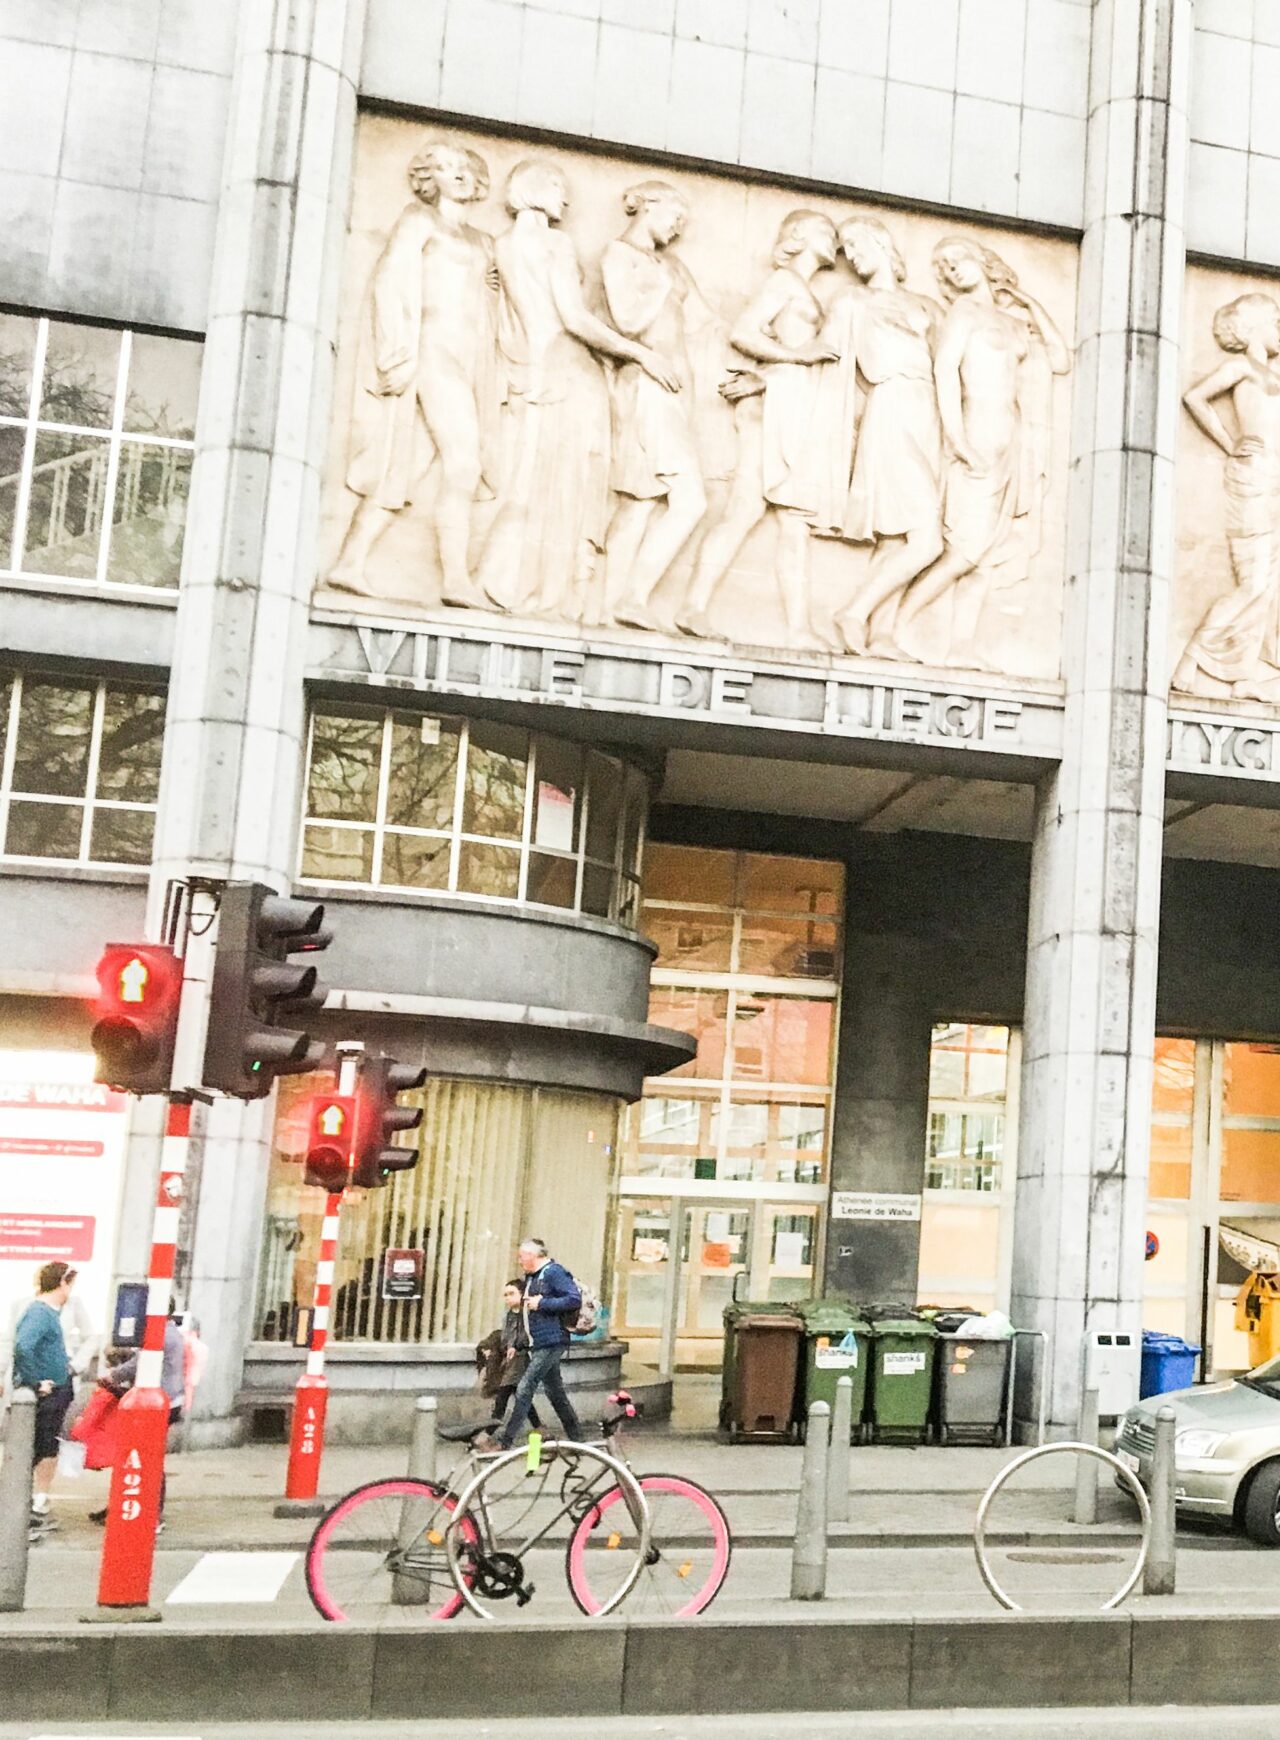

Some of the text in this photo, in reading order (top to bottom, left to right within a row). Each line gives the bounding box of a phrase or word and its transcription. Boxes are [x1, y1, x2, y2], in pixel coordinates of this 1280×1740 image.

[356, 627, 1022, 741] VILLE DE LIEGE
[34, 1084, 107, 1106] WAHA
[874, 1207, 885, 1216] de
[888, 1207, 913, 1216] Waha
